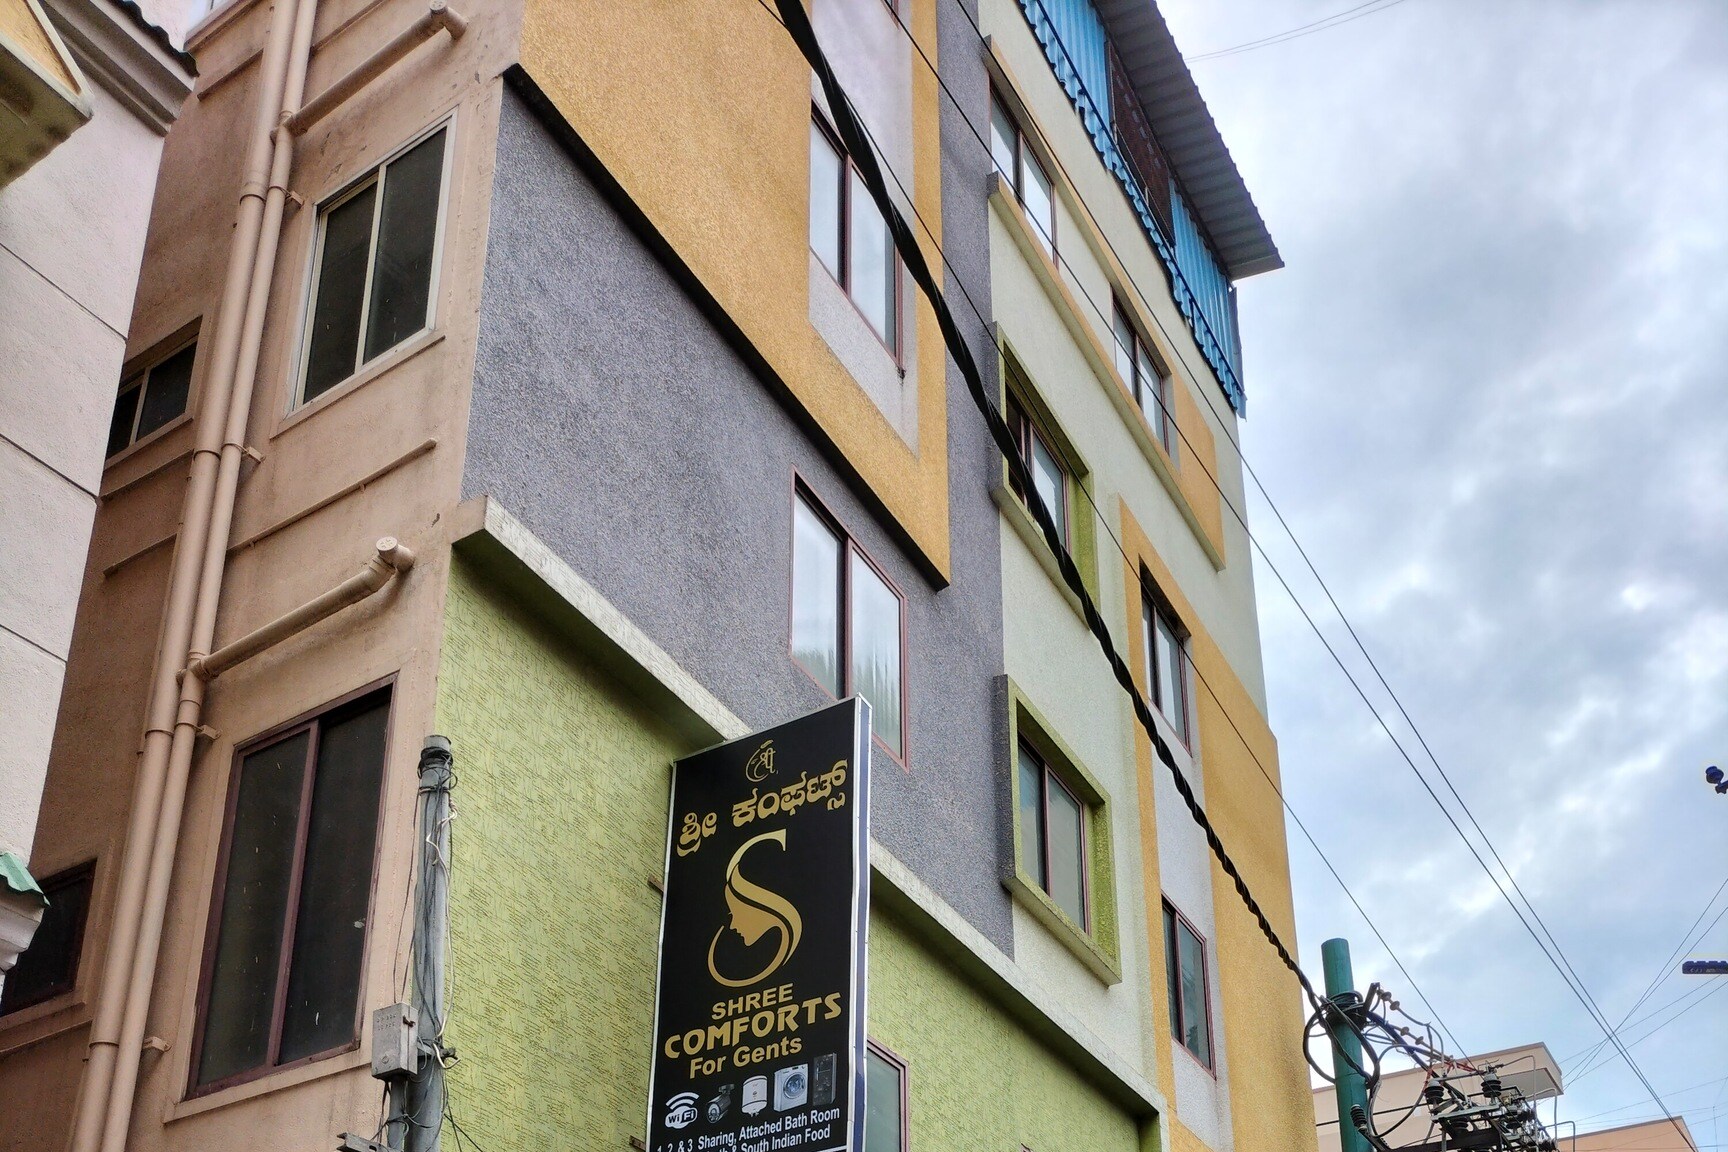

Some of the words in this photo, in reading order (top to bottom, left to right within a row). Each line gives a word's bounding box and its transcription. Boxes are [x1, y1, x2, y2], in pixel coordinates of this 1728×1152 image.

[677, 812, 718, 857] ಶ್ರೀ
[712, 982, 794, 1020] SHREE
[664, 992, 842, 1059] COMFORTS
[690, 1055, 726, 1079] For
[733, 1036, 803, 1067] Gents
[688, 1139, 693, 1152] 3
[698, 1131, 737, 1150] Sharing,
[739, 1118, 782, 1140] Attached
[785, 1111, 808, 1131] Bath
[810, 1107, 840, 1124] Room
[772, 1133, 801, 1151] Indian
[804, 1123, 831, 1143] Food
